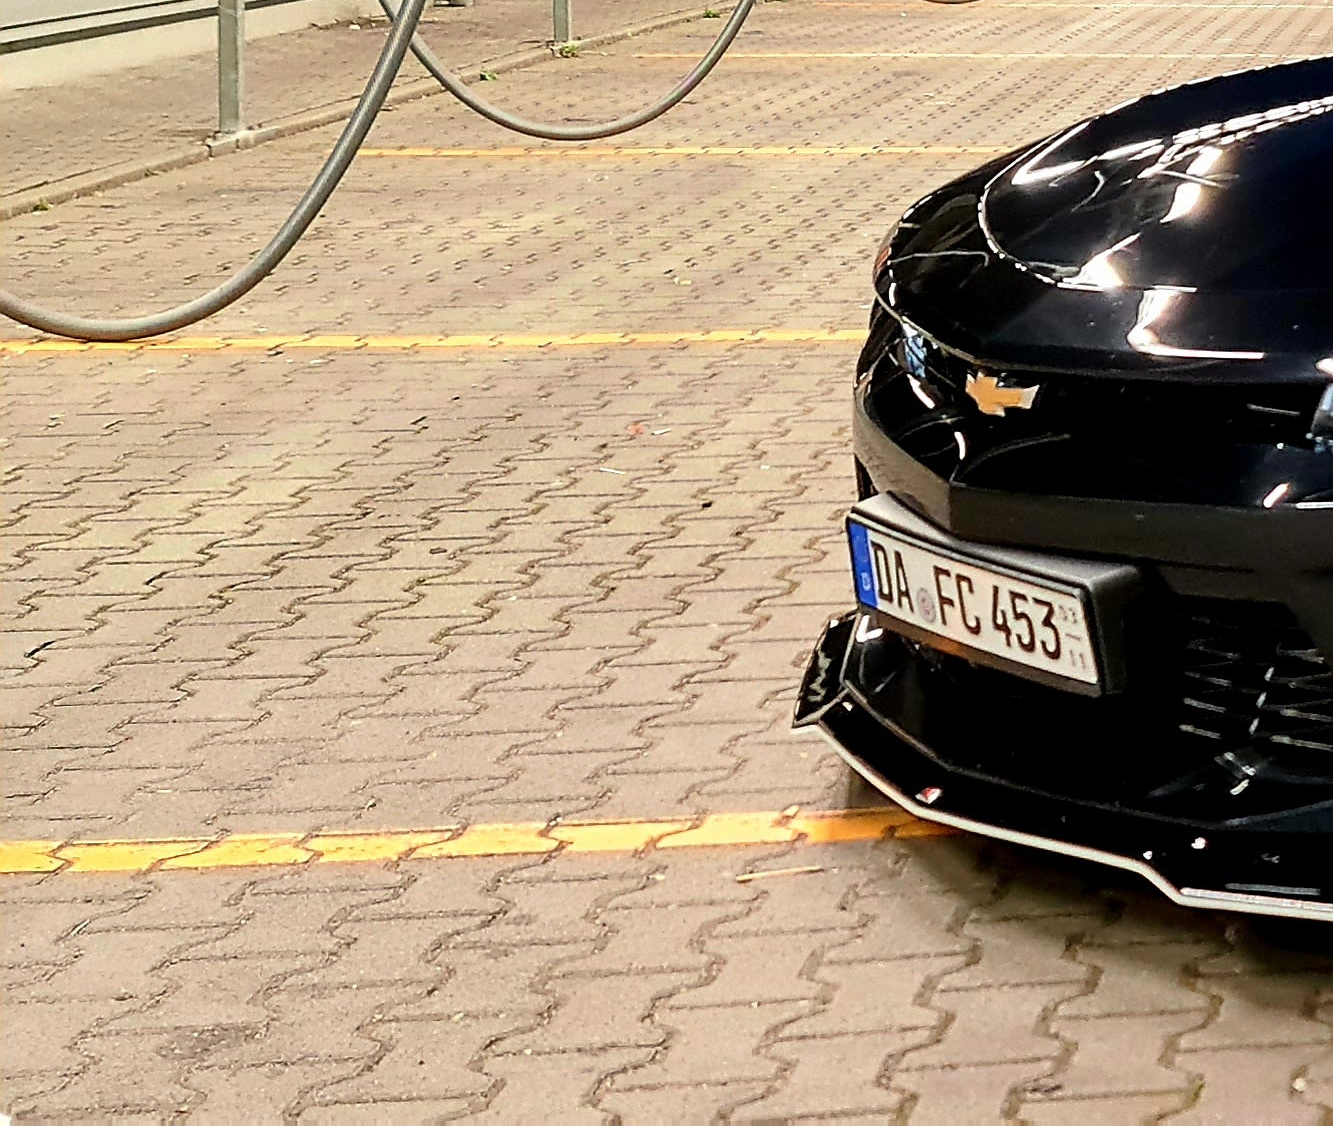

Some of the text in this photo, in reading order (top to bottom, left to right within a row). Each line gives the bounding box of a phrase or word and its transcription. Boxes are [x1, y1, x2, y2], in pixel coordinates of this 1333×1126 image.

[870, 539, 1062, 661] DA FC 453
